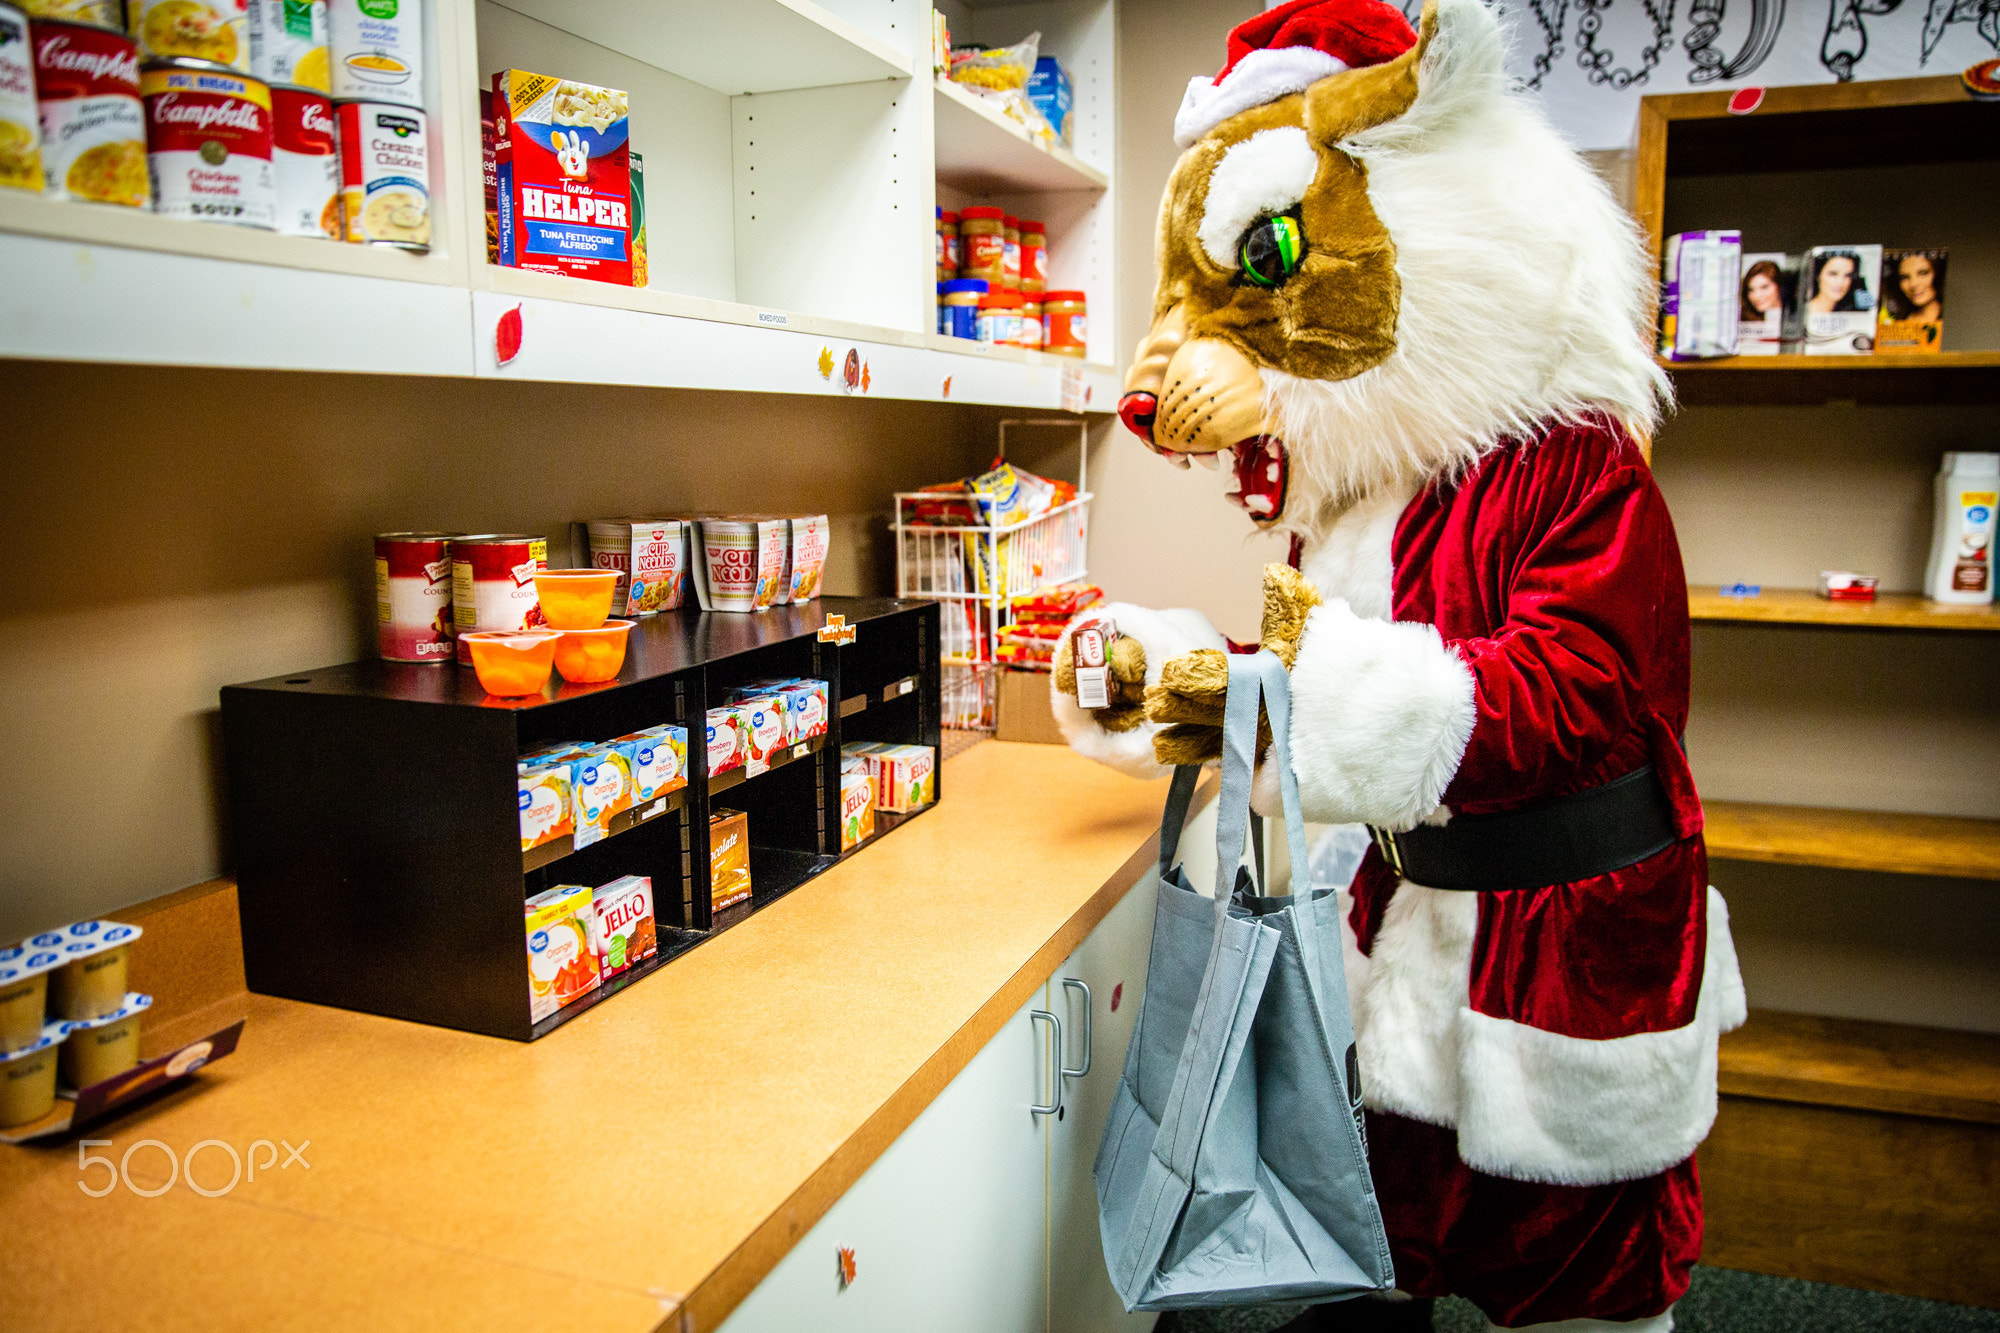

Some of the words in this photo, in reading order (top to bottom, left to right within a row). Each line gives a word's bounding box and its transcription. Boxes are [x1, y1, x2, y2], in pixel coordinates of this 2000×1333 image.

[527, 76, 545, 92] REAL
[522, 86, 545, 106] CHEESE
[371, 138, 414, 155] Cream
[376, 152, 423, 171] Chicken
[559, 177, 593, 196] Tuna
[522, 187, 629, 229] HELPER
[540, 229, 564, 240] TUNA
[565, 231, 614, 245] FETTUCCINE
[559, 239, 598, 251] ALFREDO
[647, 542, 669, 556] CUP
[638, 553, 675, 571] NOODLES
[655, 762, 673, 774] Peach
[594, 781, 618, 796] Orange
[527, 802, 555, 819] Orange
[541, 910, 558, 922] FAMILY
[546, 941, 573, 959] Orange
